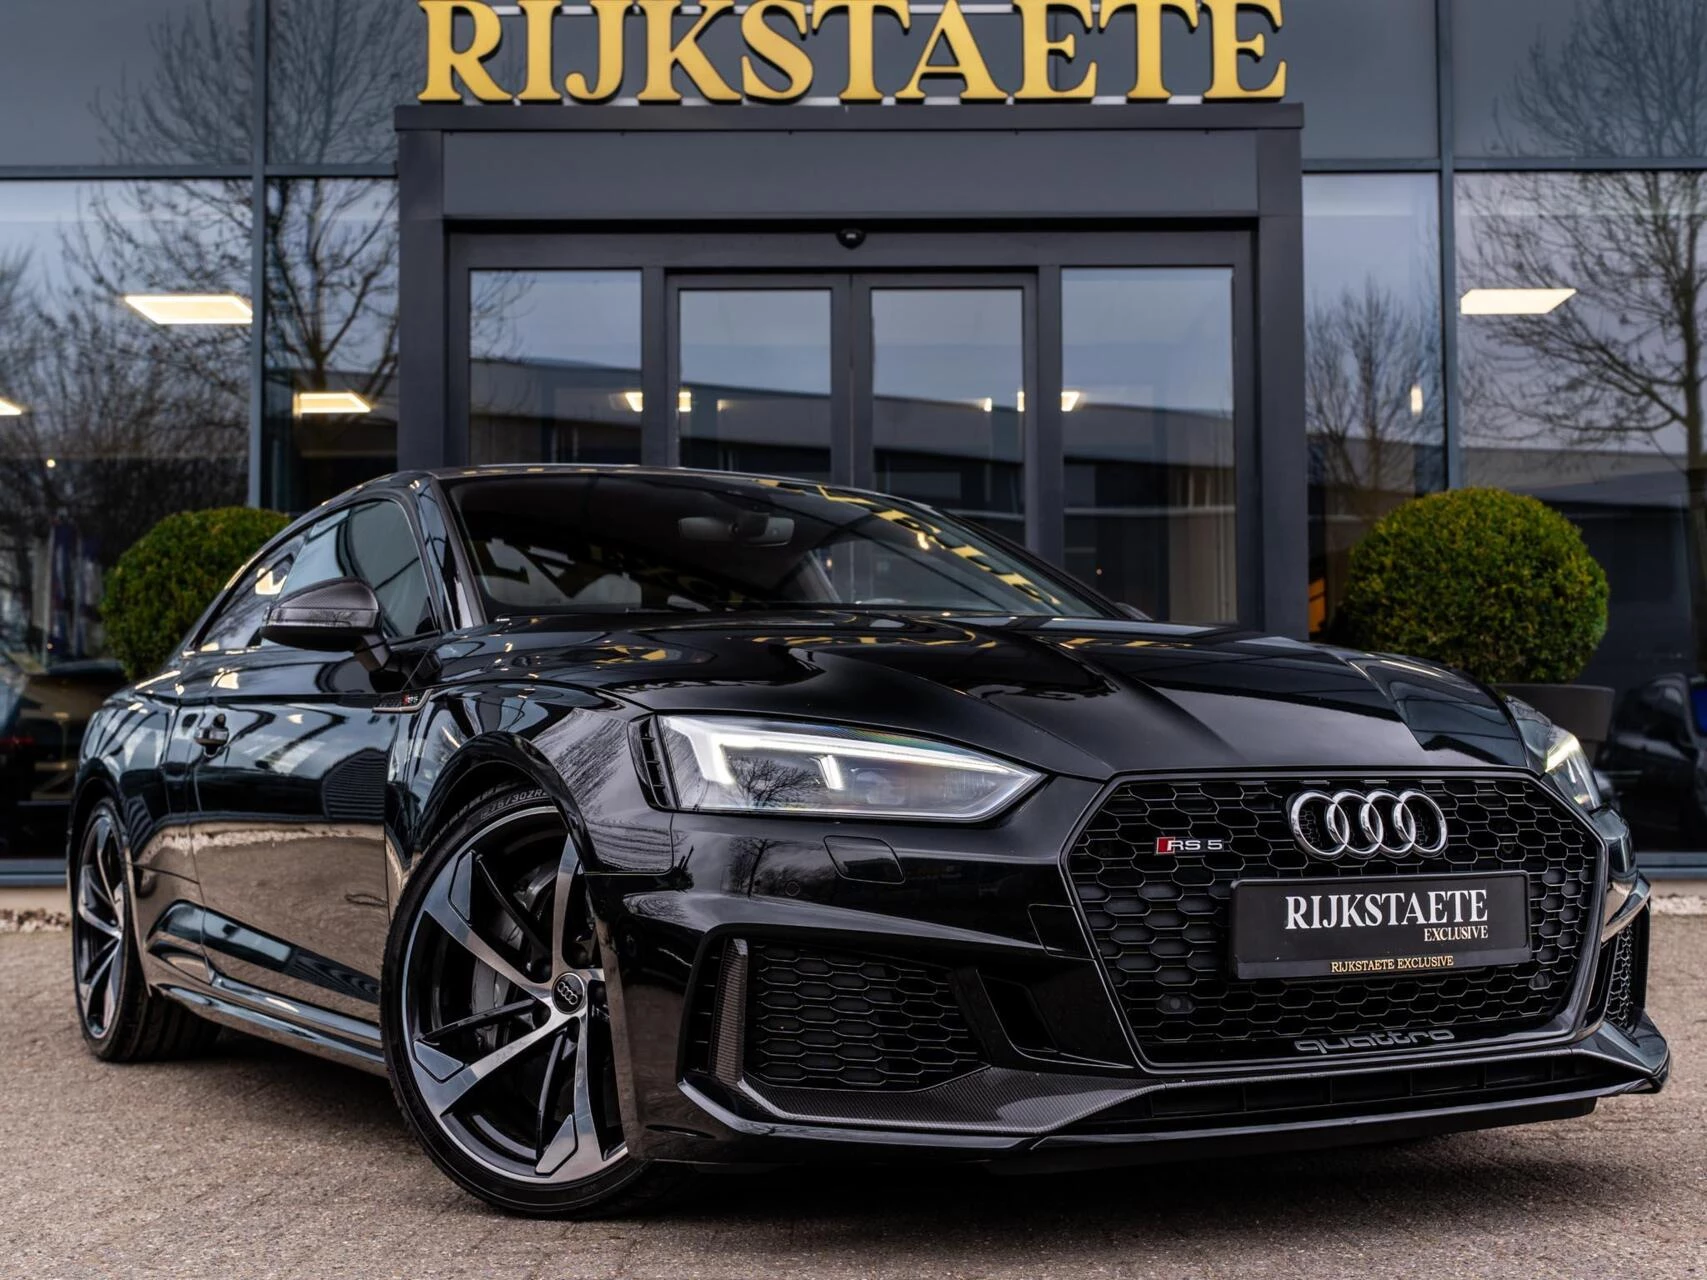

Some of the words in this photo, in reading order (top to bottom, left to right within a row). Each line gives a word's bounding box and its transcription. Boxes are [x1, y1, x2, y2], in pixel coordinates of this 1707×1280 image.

[417, 0, 1287, 102] RIJKSTAETE
[1166, 839, 1201, 851] RS
[1207, 839, 1223, 850] 5
[1285, 889, 1488, 930] RIJKSTAETE
[1424, 925, 1488, 942] EXCLUSIVE
[1331, 958, 1395, 973] RIJKSTAETE
[1397, 955, 1454, 969] EXCLUSIVE
[1294, 1029, 1455, 1055] quattro
